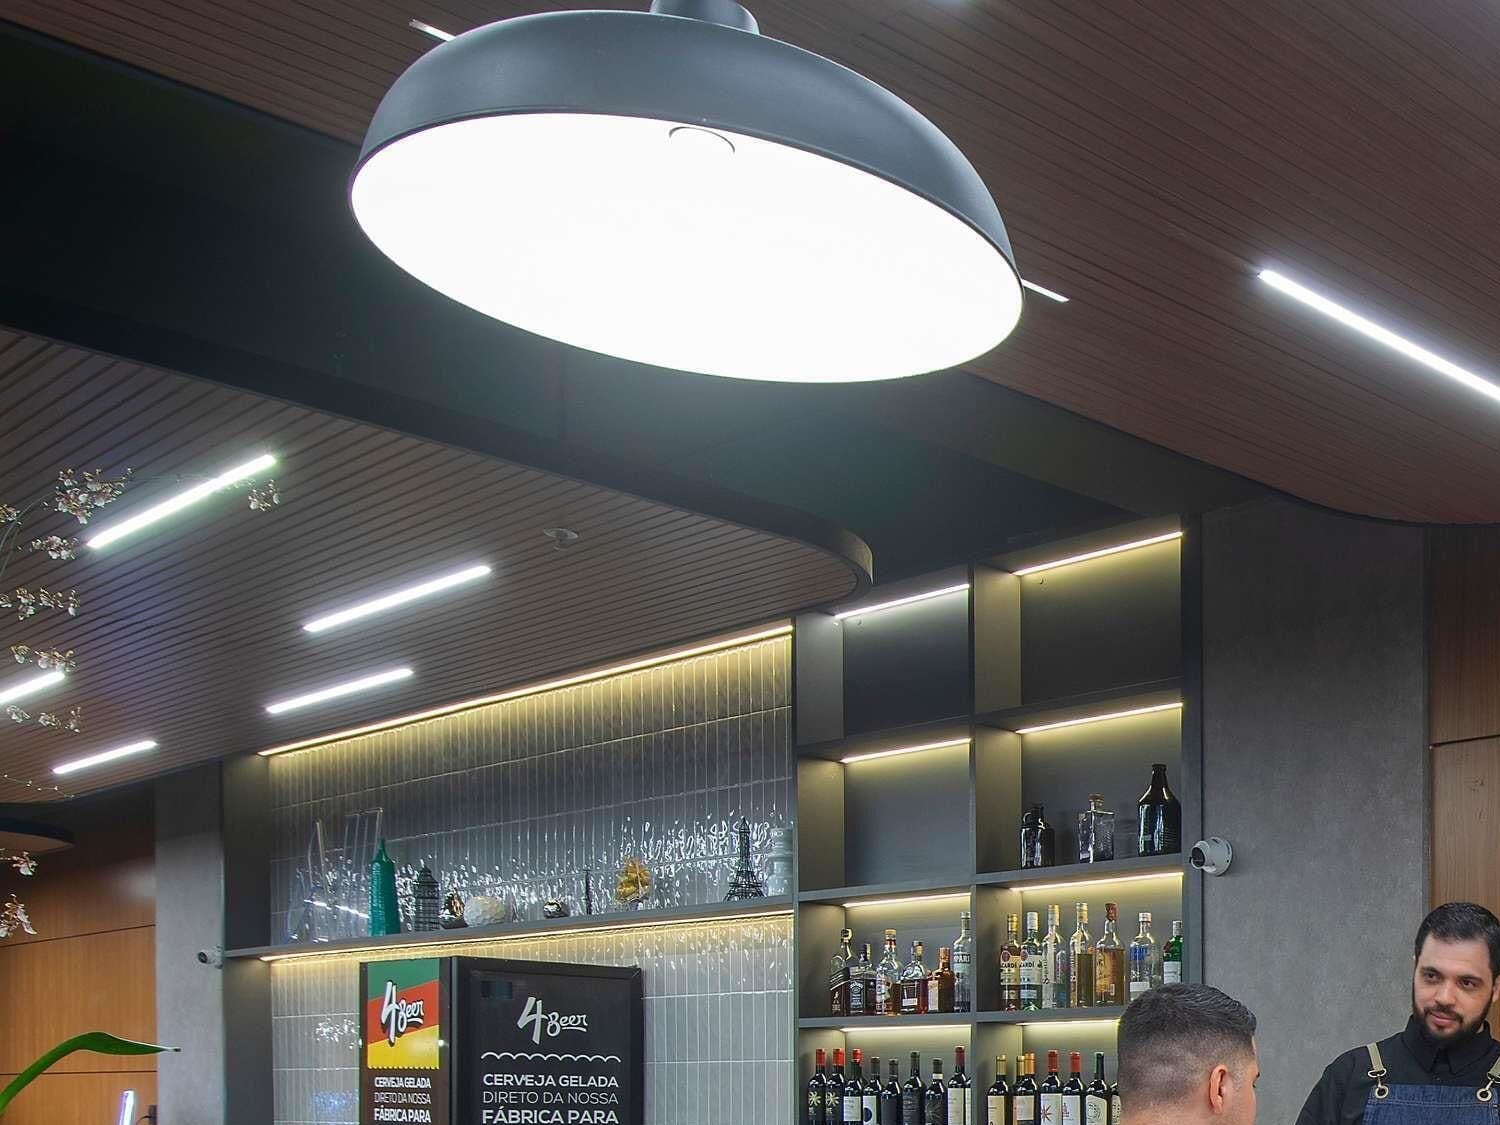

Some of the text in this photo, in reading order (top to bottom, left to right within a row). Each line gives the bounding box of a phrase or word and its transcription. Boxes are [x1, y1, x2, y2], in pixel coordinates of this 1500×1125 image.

[374, 1077, 431, 1088] CERVEJA GELADA
[483, 1074, 619, 1087] CERVEJA GELADA
[398, 1092, 407, 1103] DA
[408, 1093, 431, 1104] NOSSA
[483, 1091, 619, 1104] DIRETO DA NOSSA
[374, 1105, 431, 1122] FÁBRICA PARA
[482, 1106, 619, 1124] FÁBRICA PARA
